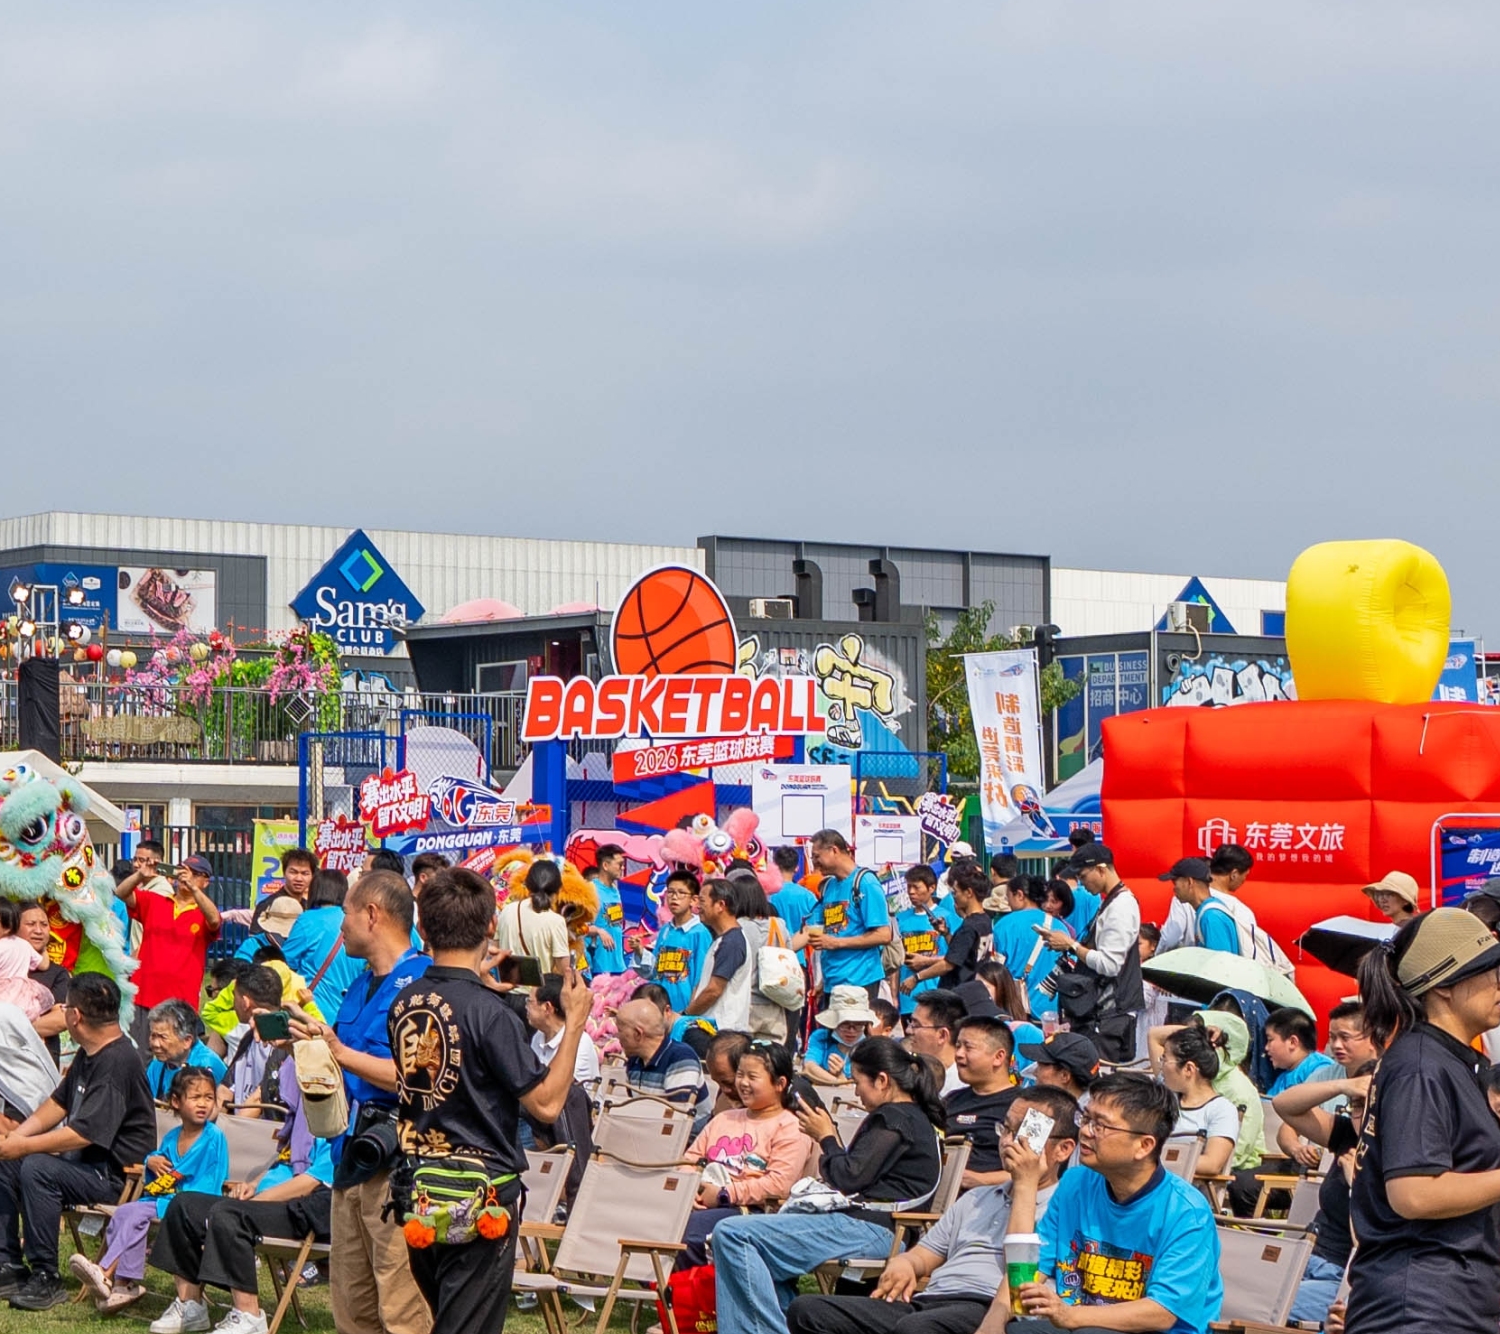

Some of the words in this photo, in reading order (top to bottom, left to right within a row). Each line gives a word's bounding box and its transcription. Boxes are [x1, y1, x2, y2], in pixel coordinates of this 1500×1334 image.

[337, 629, 384, 644] CLUB
[1104, 660, 1148, 672] BUSINESS
[1091, 673, 1146, 684] DEPARTMENT
[524, 676, 826, 739] BASKETBALL
[1090, 688, 1143, 708] 招商中心
[634, 747, 678, 777] 2026
[680, 735, 775, 767] 东莞篮球联赛
[361, 772, 416, 812] 赛出水平
[475, 804, 513, 822] 东莞
[1244, 821, 1345, 851] 东莞文旅
